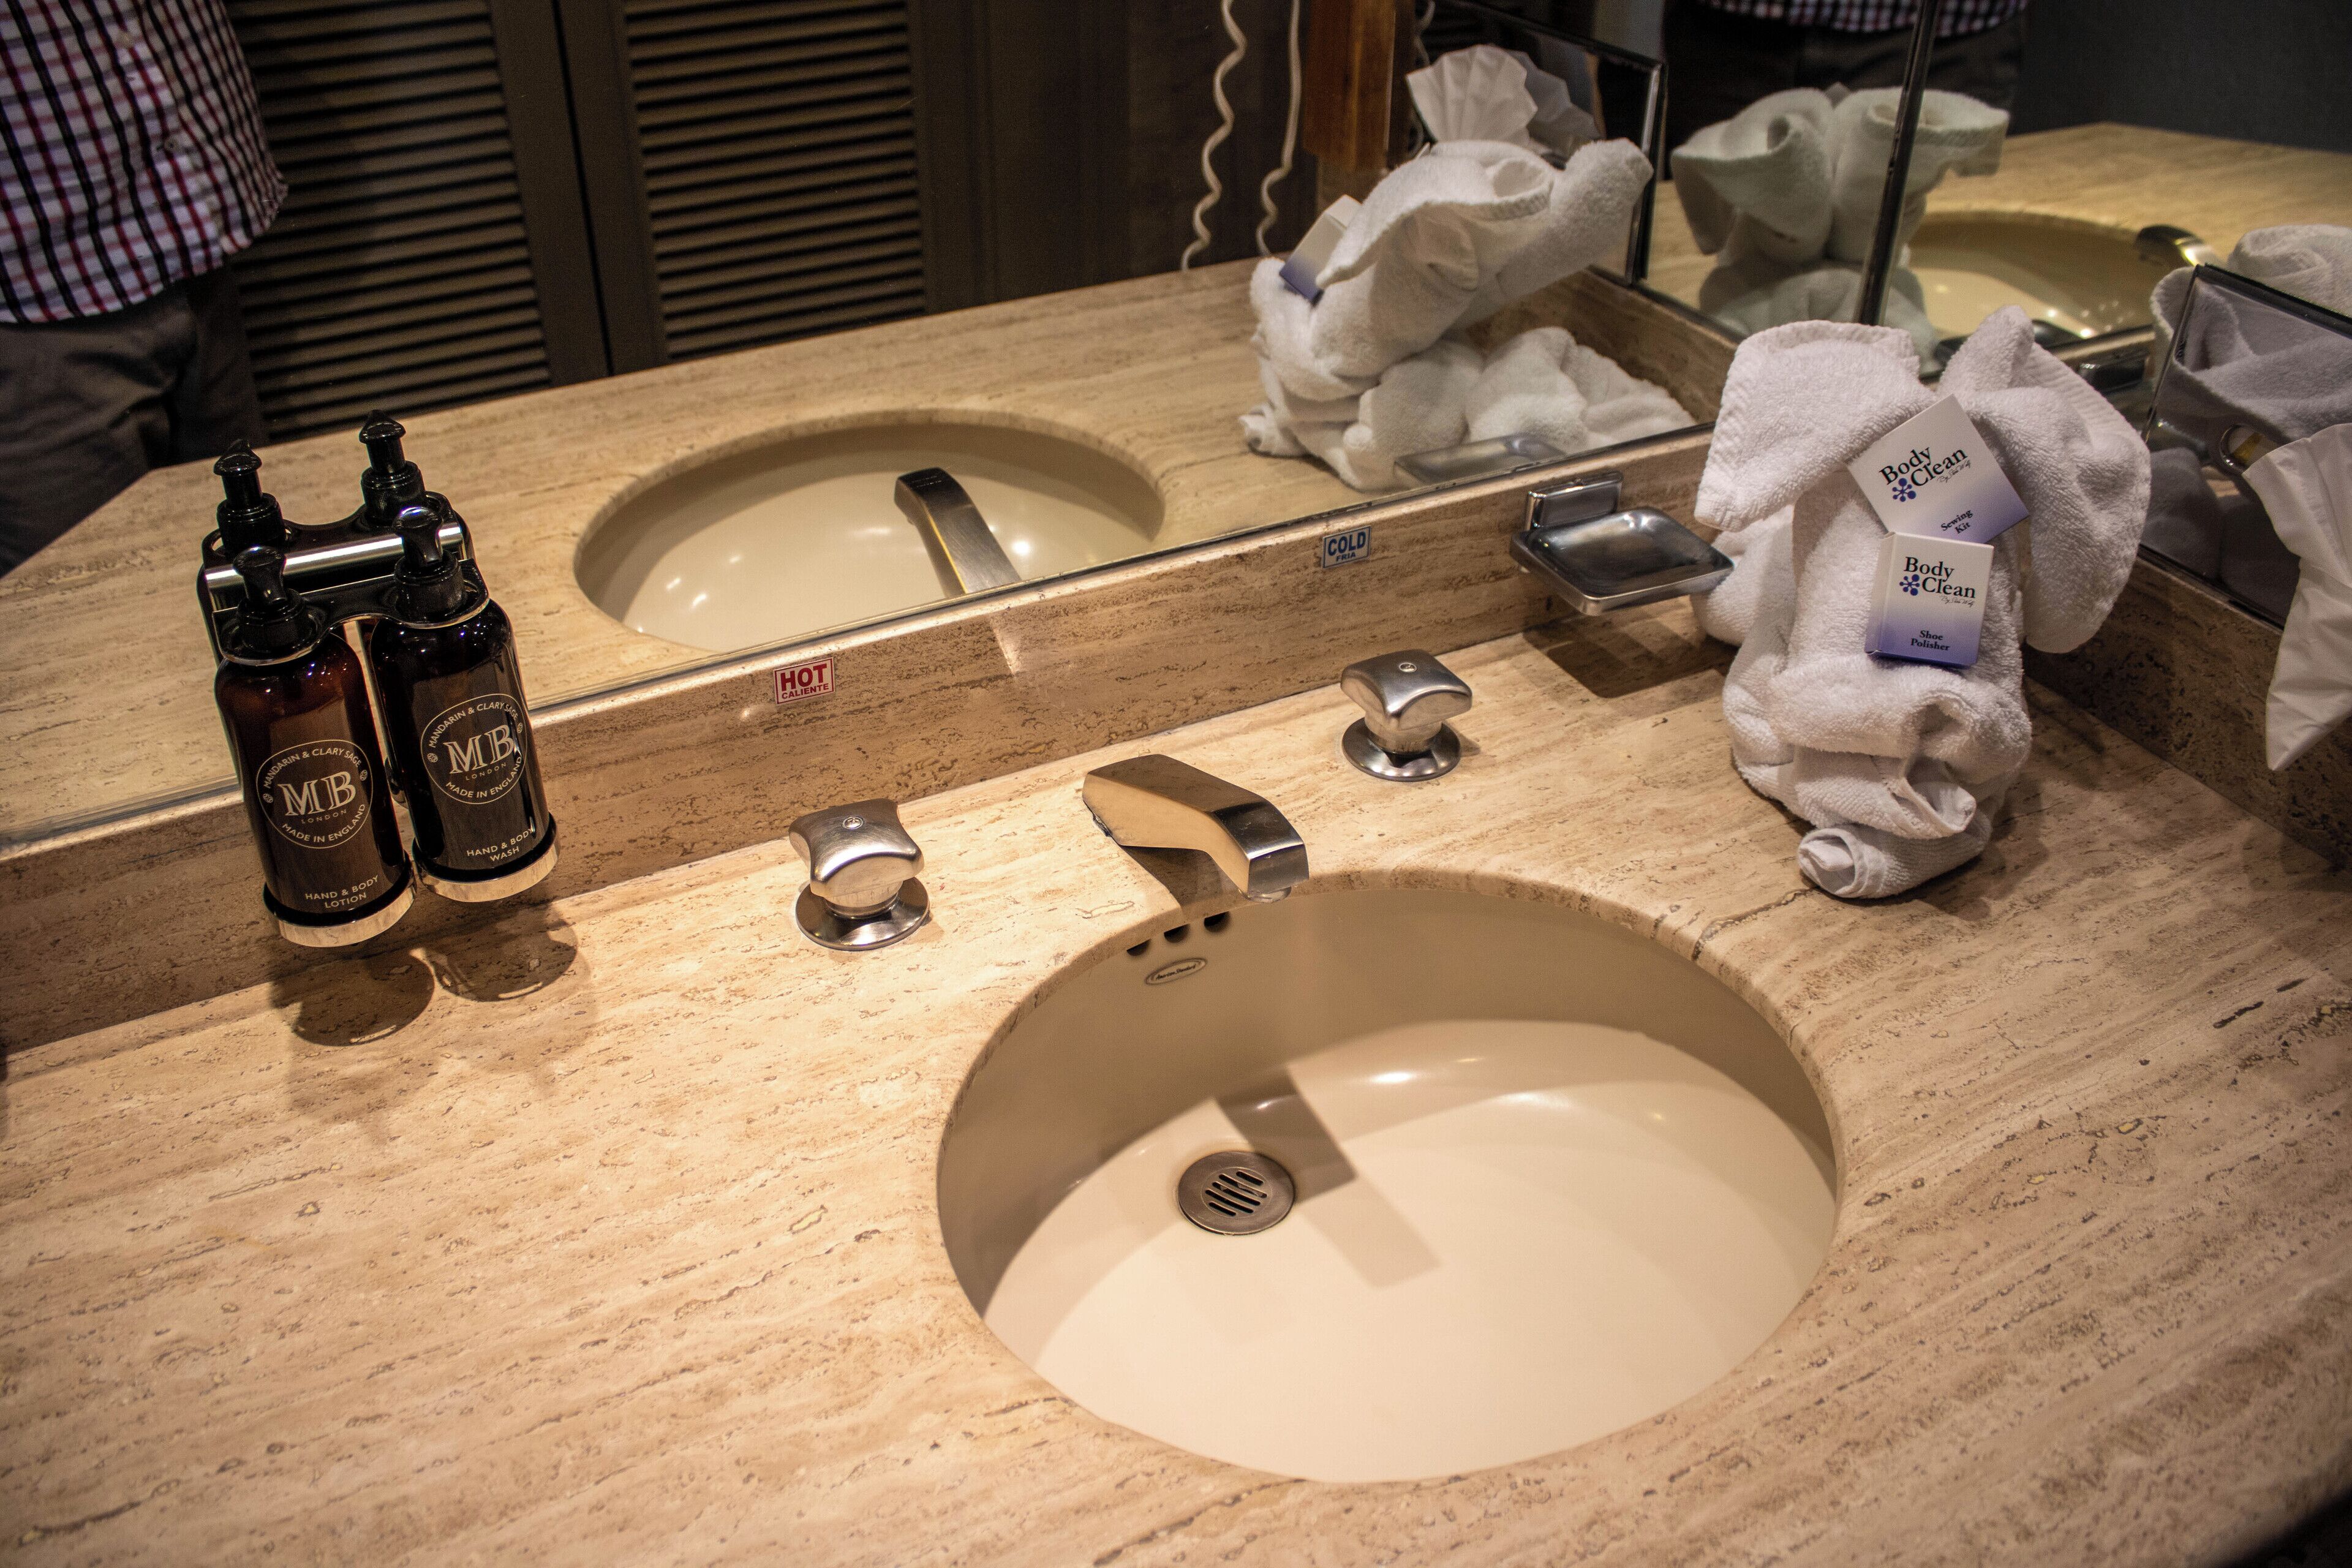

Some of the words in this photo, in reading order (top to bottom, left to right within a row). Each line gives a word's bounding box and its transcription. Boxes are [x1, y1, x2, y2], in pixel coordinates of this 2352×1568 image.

[1879, 447, 1931, 485] Body
[1910, 449, 1968, 486] Clean
[1940, 510, 1973, 531] Sewing
[1955, 521, 1971, 534] Kit
[1328, 531, 1366, 556] COLD
[1336, 552, 1356, 562] FRIA
[1904, 556, 1954, 582] Body
[1922, 577, 1976, 598] Clean
[1910, 638, 1951, 651] Polisher
[1920, 630, 1943, 641] Shoe
[780, 663, 827, 692] HOT
[782, 683, 829, 699] CALIENTE
[429, 710, 466, 748] MANDARIN
[477, 702, 504, 711] CLARY
[504, 704, 519, 721] SAGE
[443, 725, 514, 774] MB
[263, 754, 300, 789] MANDARIN
[344, 750, 362, 767] SAGE
[445, 782, 475, 798] MADE
[491, 756, 522, 795] ENGLAND
[466, 762, 507, 781] LONDON
[277, 771, 356, 816] MB
[282, 823, 311, 842] MADE
[328, 804, 366, 841] ENGLAND
[301, 809, 347, 824] LONDON
[467, 845, 498, 856] HAND
[510, 829, 533, 845] BODY
[489, 846, 519, 862] WASH
[305, 891, 337, 900] HAND
[352, 875, 378, 892] BODY
[324, 892, 367, 908] LOTION
